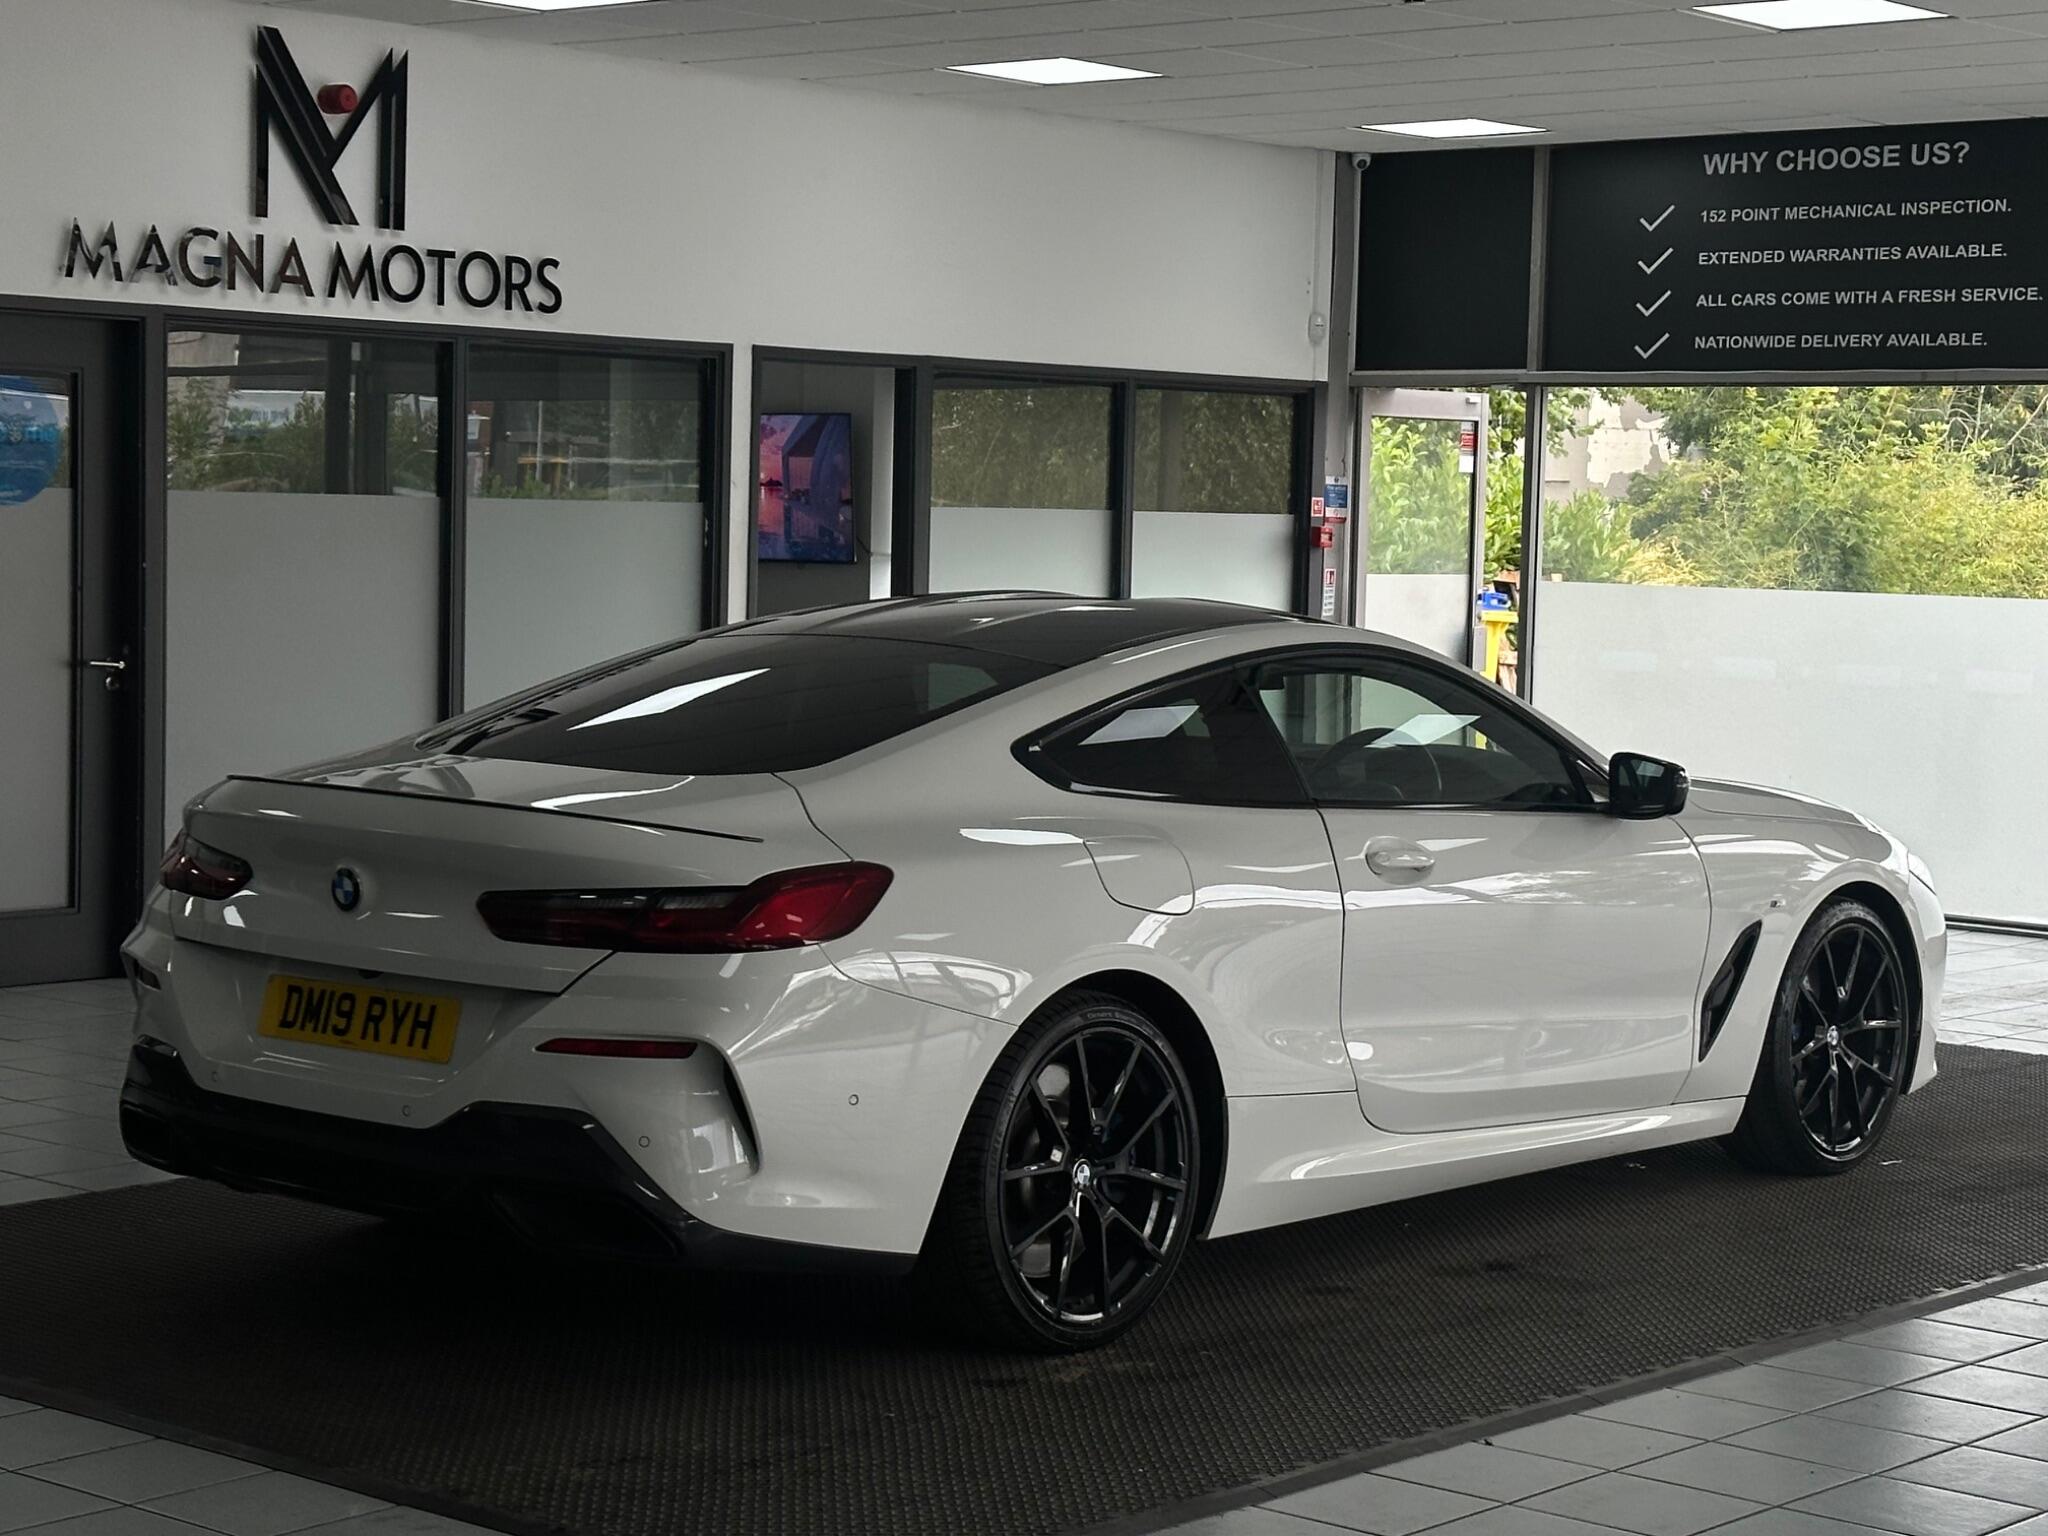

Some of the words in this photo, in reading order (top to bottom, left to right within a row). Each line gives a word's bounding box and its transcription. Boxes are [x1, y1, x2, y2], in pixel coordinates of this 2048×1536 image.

[1703, 151, 1769, 175] WHY
[1775, 145, 1901, 172] CHOOSE
[1911, 141, 1970, 166] US?
[1700, 209, 1727, 223] 152
[1731, 207, 1780, 222] POINT
[1785, 203, 1897, 220] MECHANICAL
[1900, 198, 2012, 216] INSPECTION.
[63, 216, 316, 298] MAGNA
[327, 241, 563, 314] MOTORS
[1698, 250, 1785, 265] EXTENDED
[1789, 246, 1901, 263] WARRANTIES
[1905, 243, 2008, 260] AVAILABLE.
[1696, 294, 1727, 307] ALL
[1731, 293, 1777, 306] CARS
[1781, 291, 1831, 305] COME
[1835, 290, 1877, 304] WITH
[1881, 290, 1894, 303] A
[1898, 288, 1956, 303] FRESH
[1960, 287, 2043, 302] SERVICE.
[1694, 335, 1797, 349] NATIONWIDE
[1801, 333, 1883, 348] DELIVERY
[1886, 332, 1988, 347] AVAILABLE.
[278, 983, 357, 1038] DM19
[360, 995, 438, 1051] RYH
